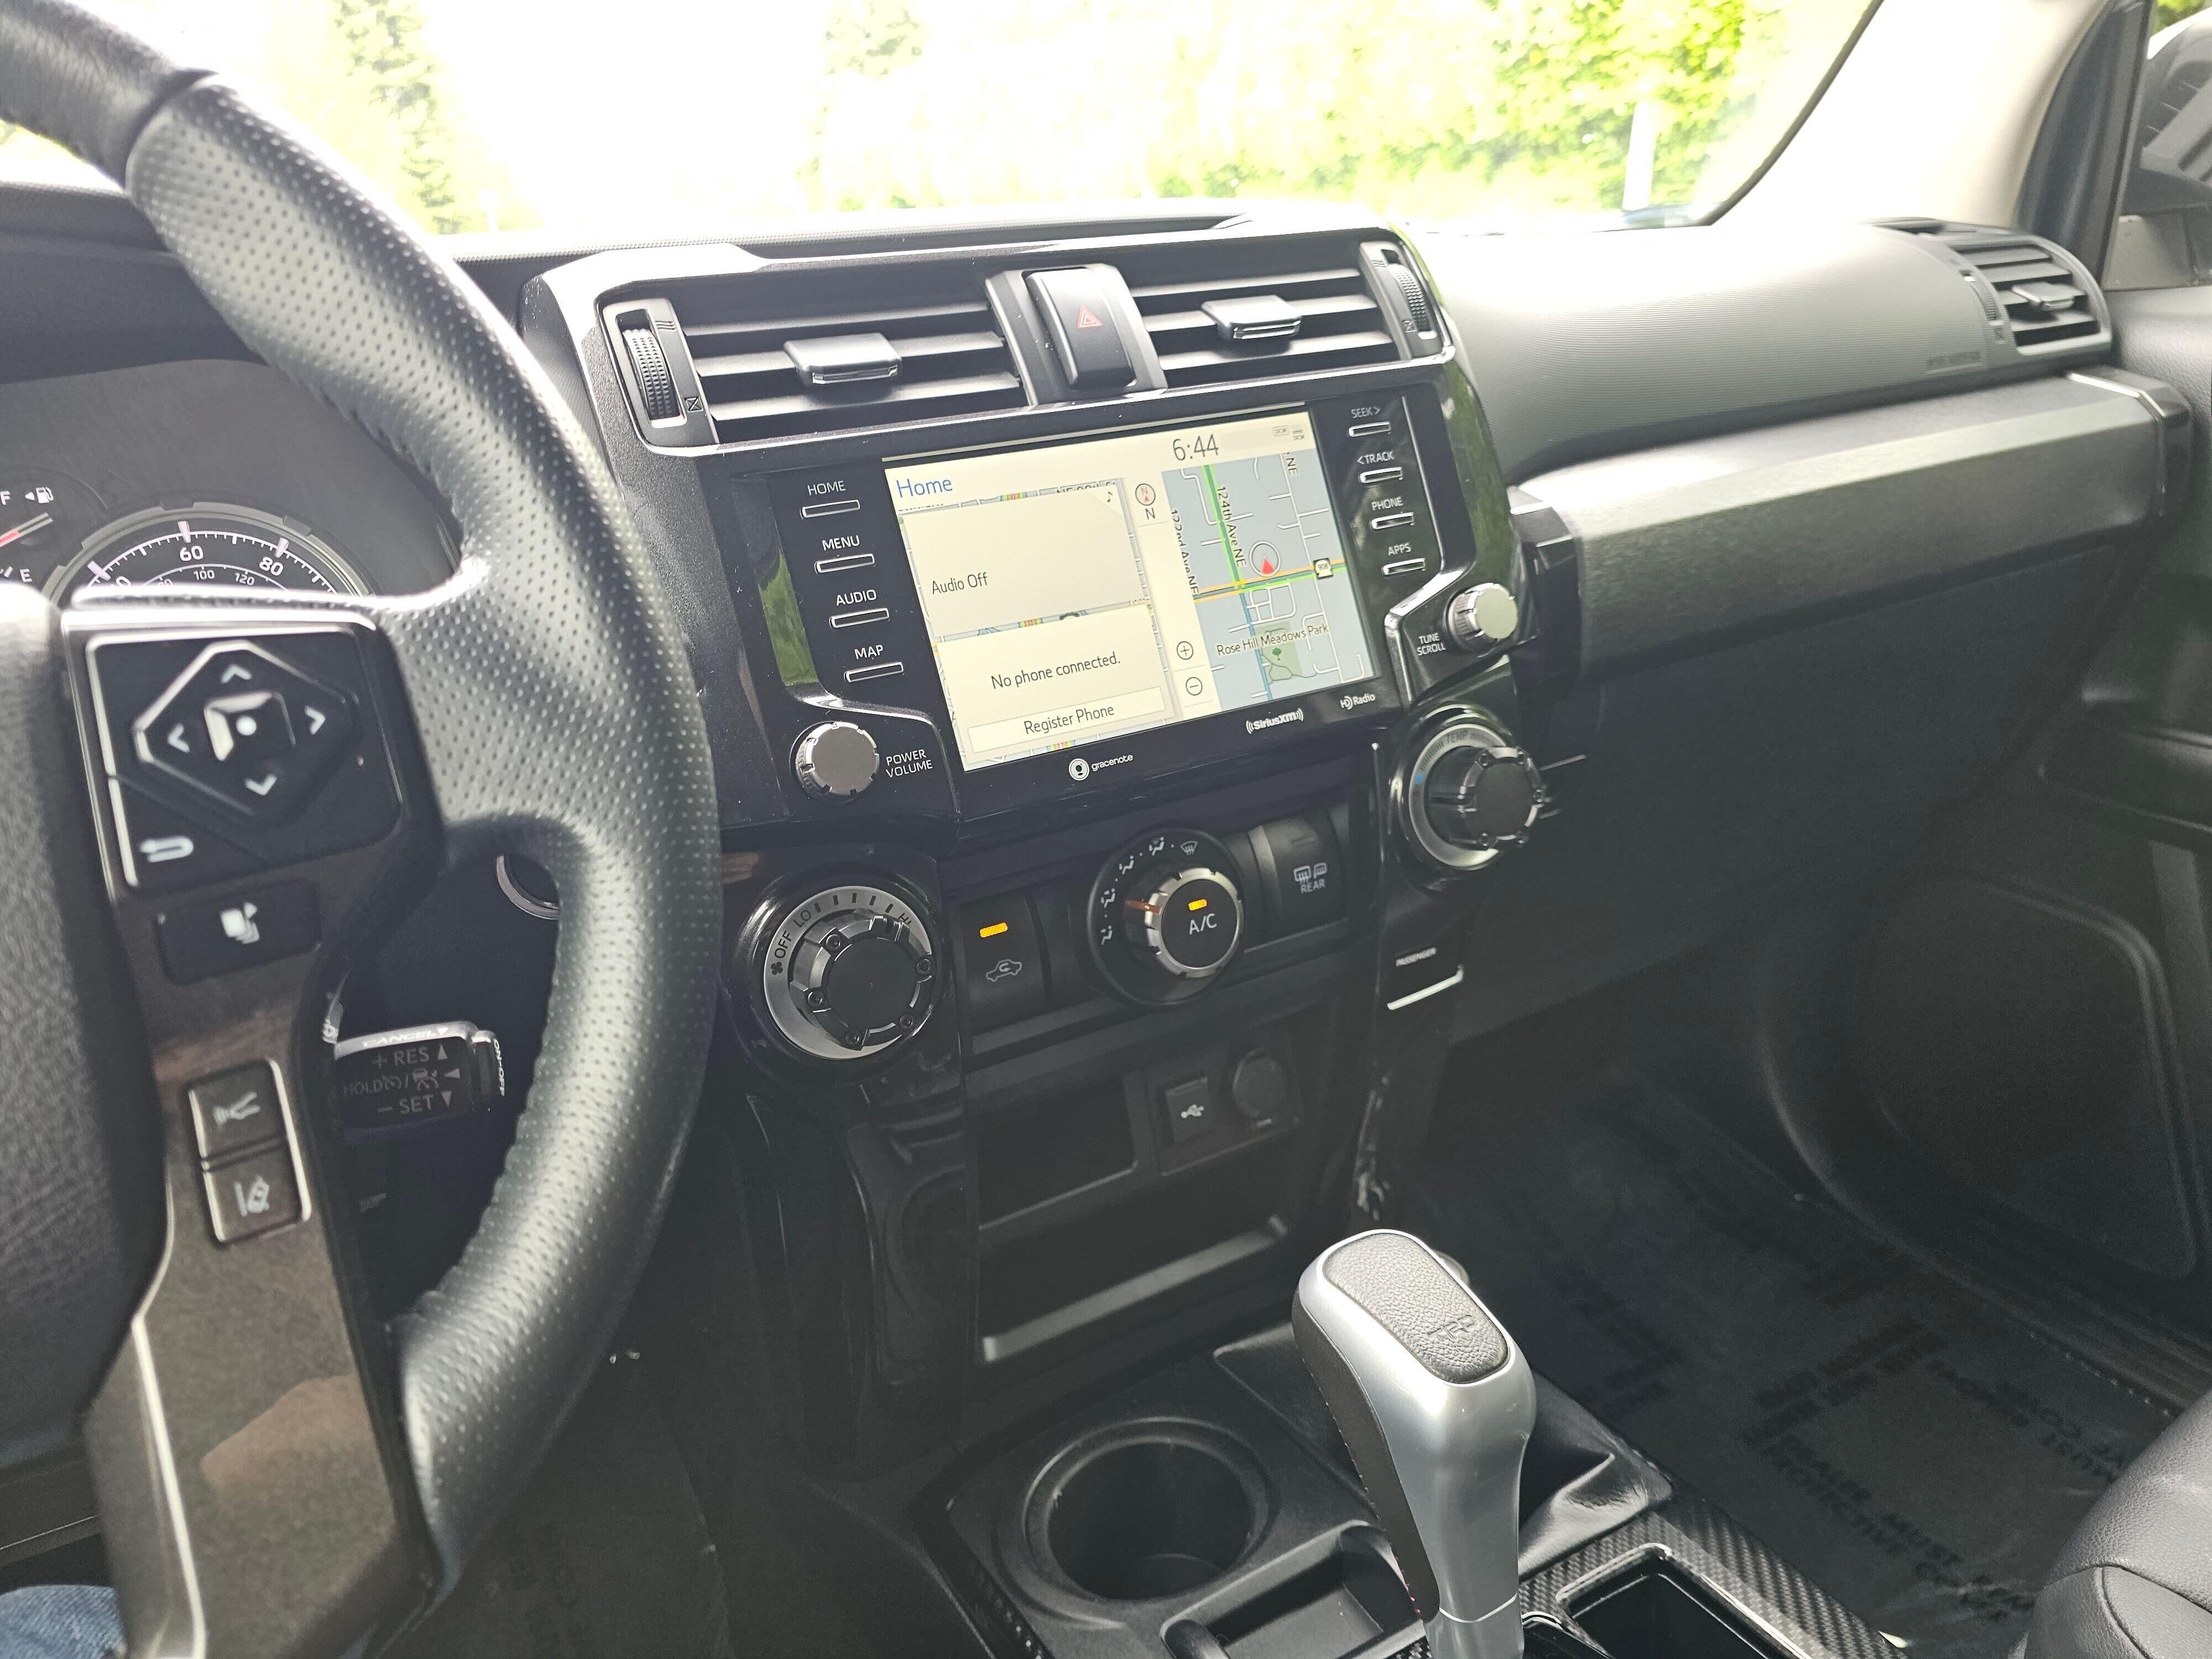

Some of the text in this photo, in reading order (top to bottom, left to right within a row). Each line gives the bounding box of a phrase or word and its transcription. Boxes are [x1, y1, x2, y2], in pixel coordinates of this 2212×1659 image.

[1172, 434, 1219, 461] 6:44
[1286, 457, 1298, 476] NE
[807, 480, 847, 496] HOME
[896, 477, 953, 498] Home
[0, 490, 11, 505] F
[1371, 496, 1404, 511] PHONE
[1145, 507, 1156, 520] N
[1217, 486, 1247, 567] 124th Ave NE
[822, 534, 861, 552] MENU
[1388, 542, 1412, 556] APPS
[179, 545, 204, 562] 60
[258, 556, 284, 576] 80
[19, 568, 33, 583] E
[193, 569, 216, 581] 100
[234, 572, 255, 586] 120
[932, 572, 988, 595] Audio Off
[836, 589, 877, 606] AUDIO
[1216, 623, 1329, 656] Rose Hill Meadows Park
[1418, 632, 1441, 644] TUNE
[854, 644, 884, 660] MAP
[1416, 642, 1447, 656] SCROLL
[990, 651, 1121, 690] No phone connected.
[1353, 693, 1376, 706] Radio
[1024, 706, 1115, 735] Register Phone
[886, 749, 927, 766] POWER
[1091, 754, 1134, 771] gracenote
[885, 759, 933, 778] VOLUME
[1300, 878, 1327, 894] REAR
[793, 910, 812, 928] LO
[1189, 913, 1218, 935] A/C
[774, 930, 792, 959] OFF
[393, 1045, 430, 1067] RES
[399, 1093, 435, 1115] SET
